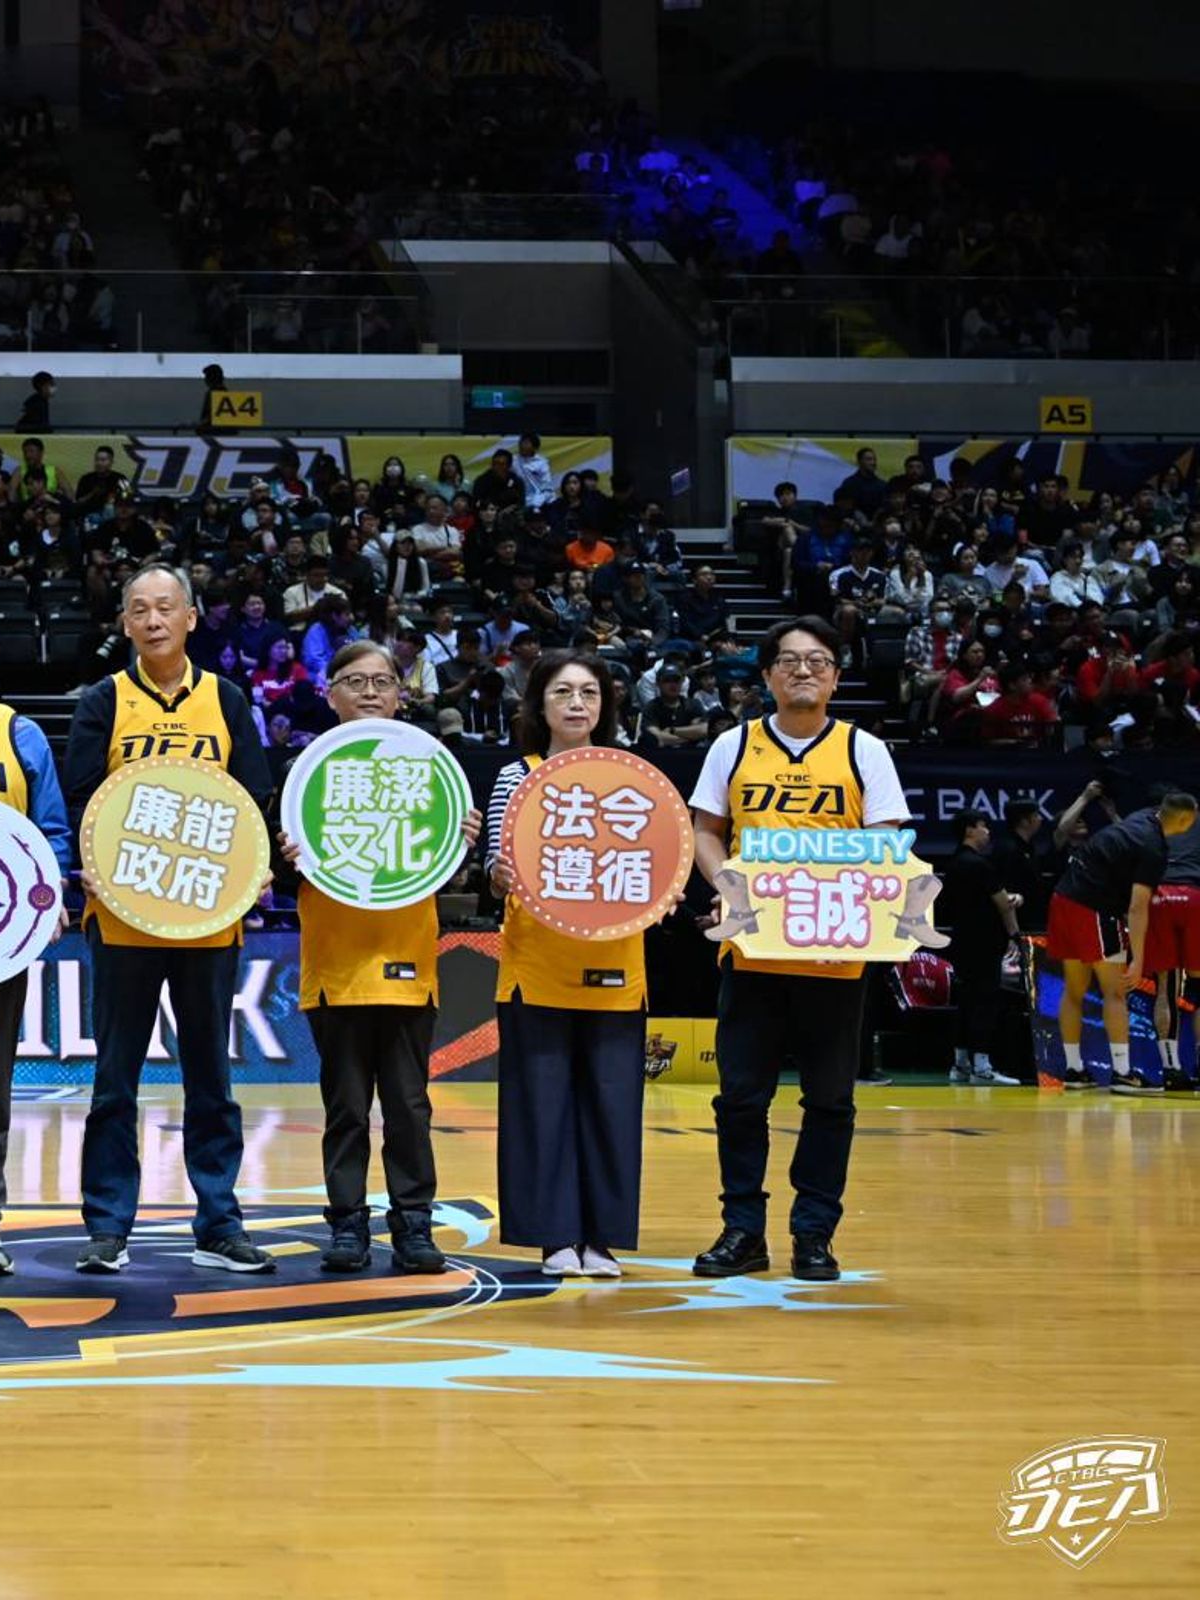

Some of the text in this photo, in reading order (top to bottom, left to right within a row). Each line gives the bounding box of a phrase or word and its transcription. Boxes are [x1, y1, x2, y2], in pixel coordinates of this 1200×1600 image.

[216, 396, 259, 417] A4
[1045, 404, 1086, 425] A5
[152, 722, 187, 731] CTBC
[322, 759, 433, 812] 廉潔
[741, 784, 845, 815] DEA
[775, 774, 811, 783] CTBC
[123, 784, 237, 854] 廉能
[541, 785, 654, 841] 法令
[322, 817, 433, 873] 文化
[743, 828, 915, 860] HONESTY
[112, 840, 226, 910] 政府
[540, 846, 652, 904] 遵循
